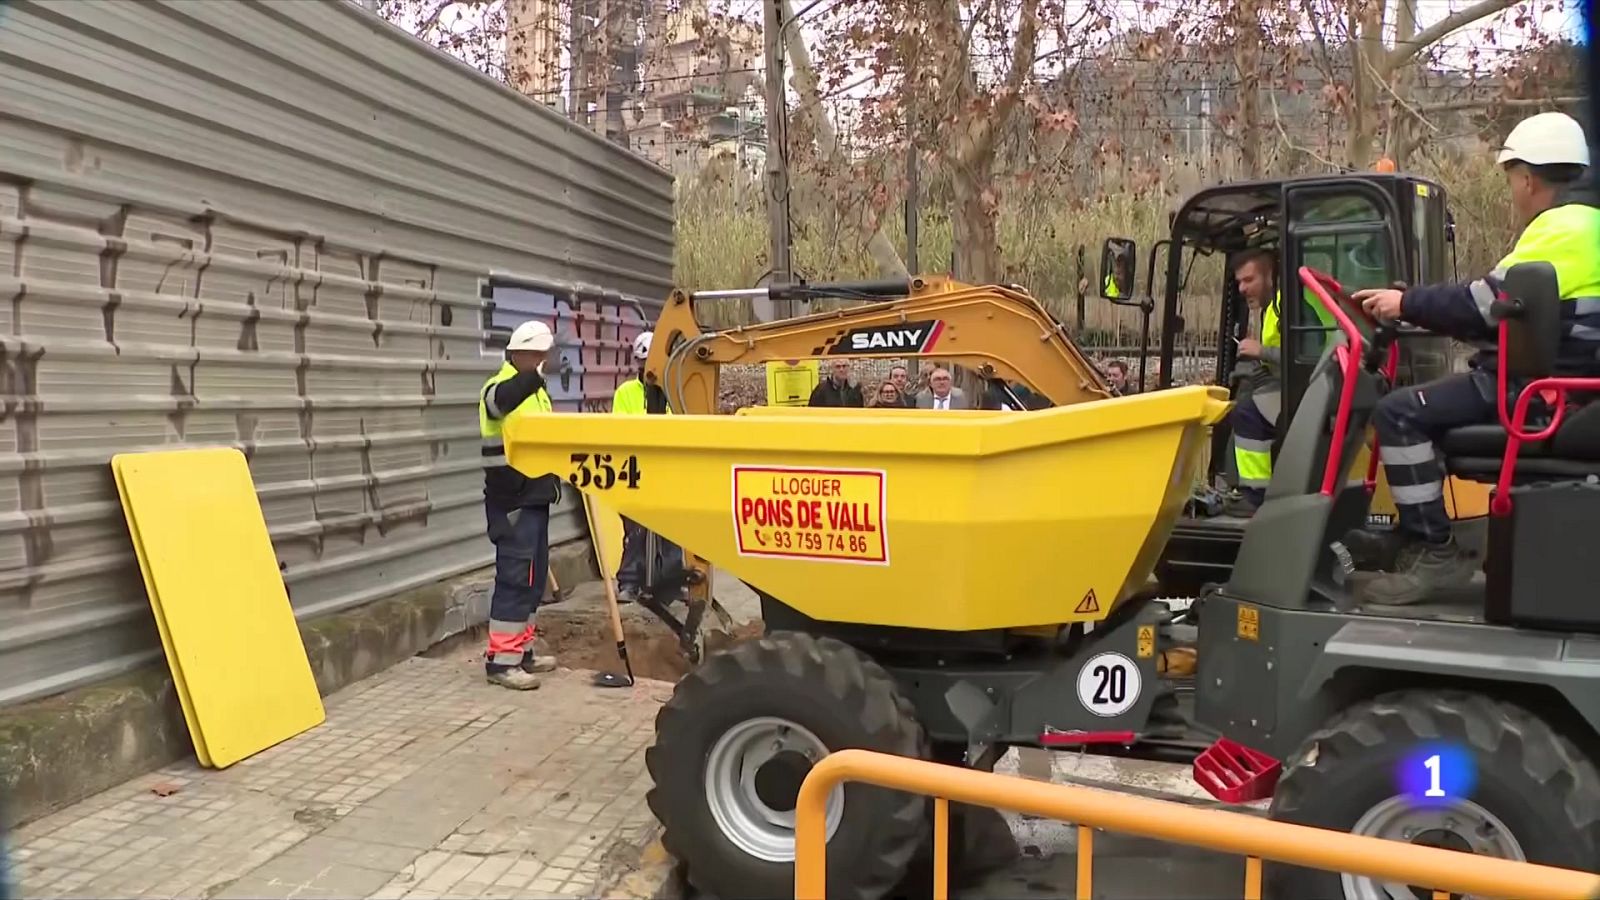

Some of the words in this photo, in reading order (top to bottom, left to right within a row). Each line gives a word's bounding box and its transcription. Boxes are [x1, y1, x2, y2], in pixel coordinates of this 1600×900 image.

[851, 329, 921, 350] SANY
[569, 453, 641, 490] 354
[771, 476, 841, 497] LLOGUER
[741, 497, 794, 529] PONS
[797, 500, 823, 530] DE
[826, 501, 876, 532] VALL
[774, 531, 793, 549] 93
[796, 532, 822, 551] 759
[826, 534, 845, 551] 74
[848, 535, 868, 553] 86
[1092, 664, 1127, 705] 20
